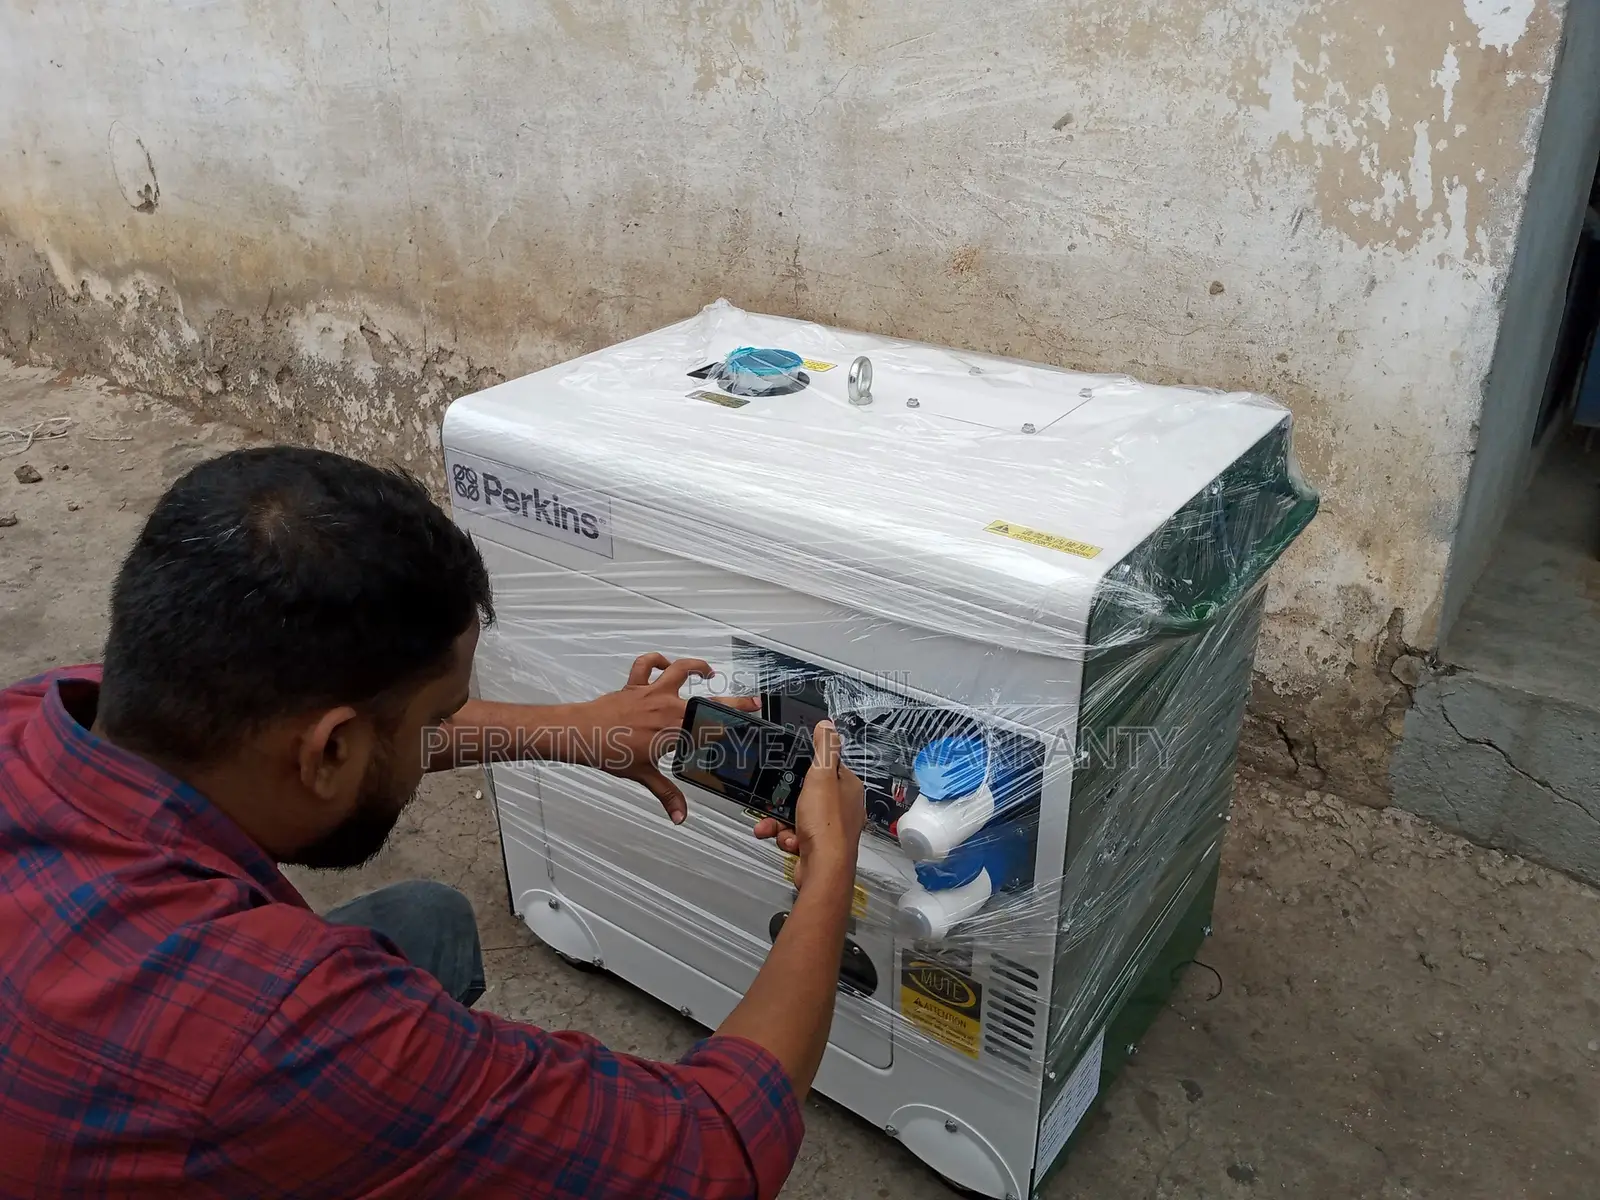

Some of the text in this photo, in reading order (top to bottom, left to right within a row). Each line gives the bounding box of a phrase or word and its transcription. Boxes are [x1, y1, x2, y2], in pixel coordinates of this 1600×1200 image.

[482, 472, 600, 540] Perkins
[921, 968, 963, 1001] MUTE
[923, 1001, 967, 1029] ATTENTION
